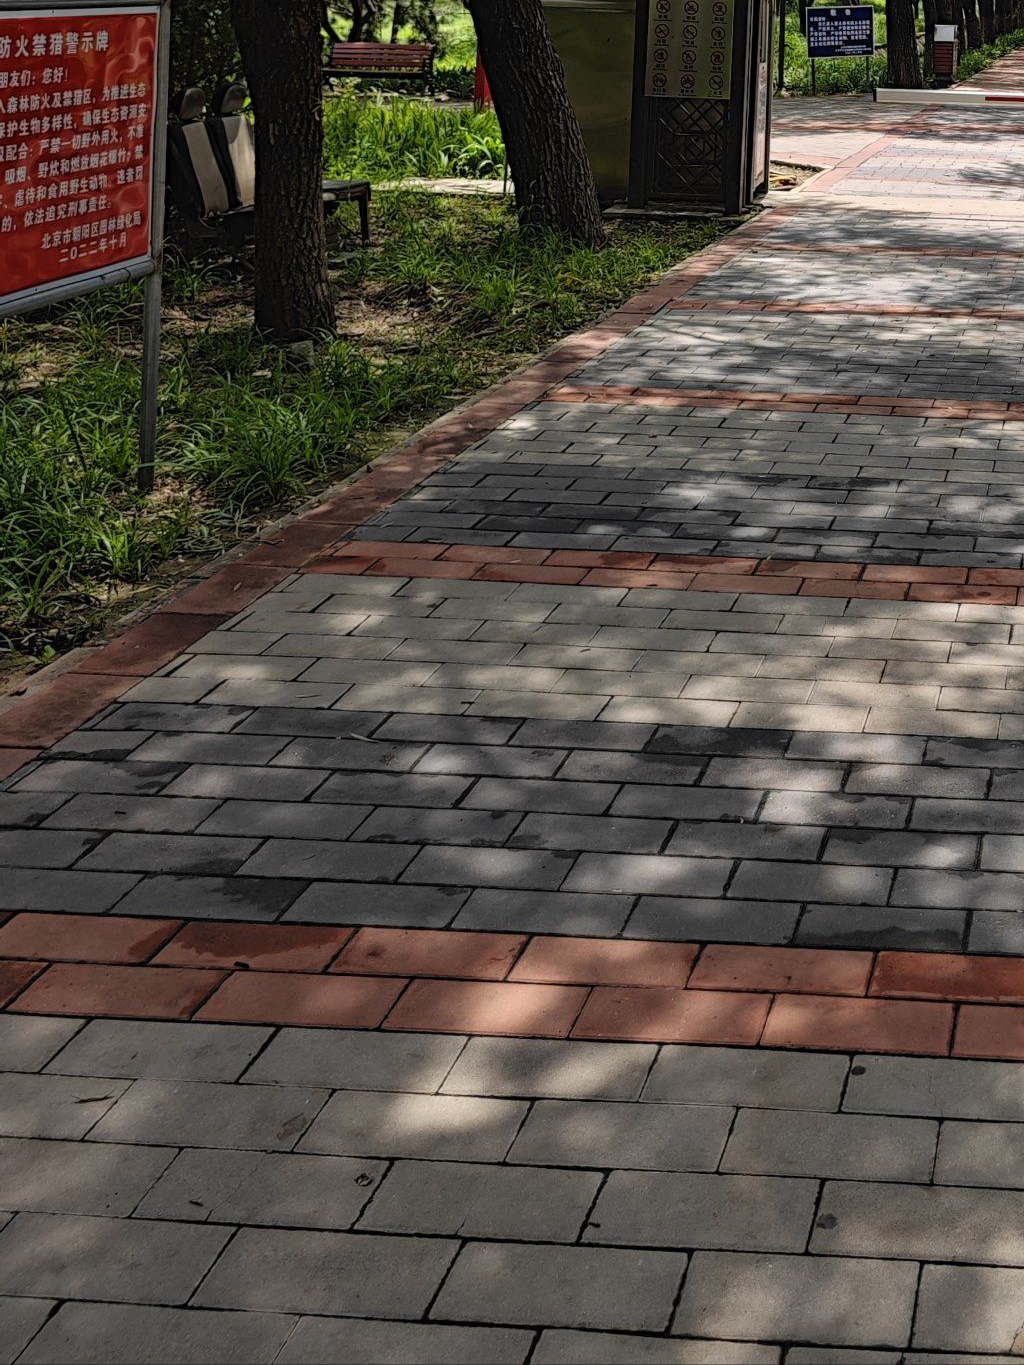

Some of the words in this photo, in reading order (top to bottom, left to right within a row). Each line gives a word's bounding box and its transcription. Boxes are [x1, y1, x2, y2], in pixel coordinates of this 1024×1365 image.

[0, 30, 109, 59] 防火禁猎警示牌
[41, 211, 142, 250] 北京市朝阳区园林绿化局
